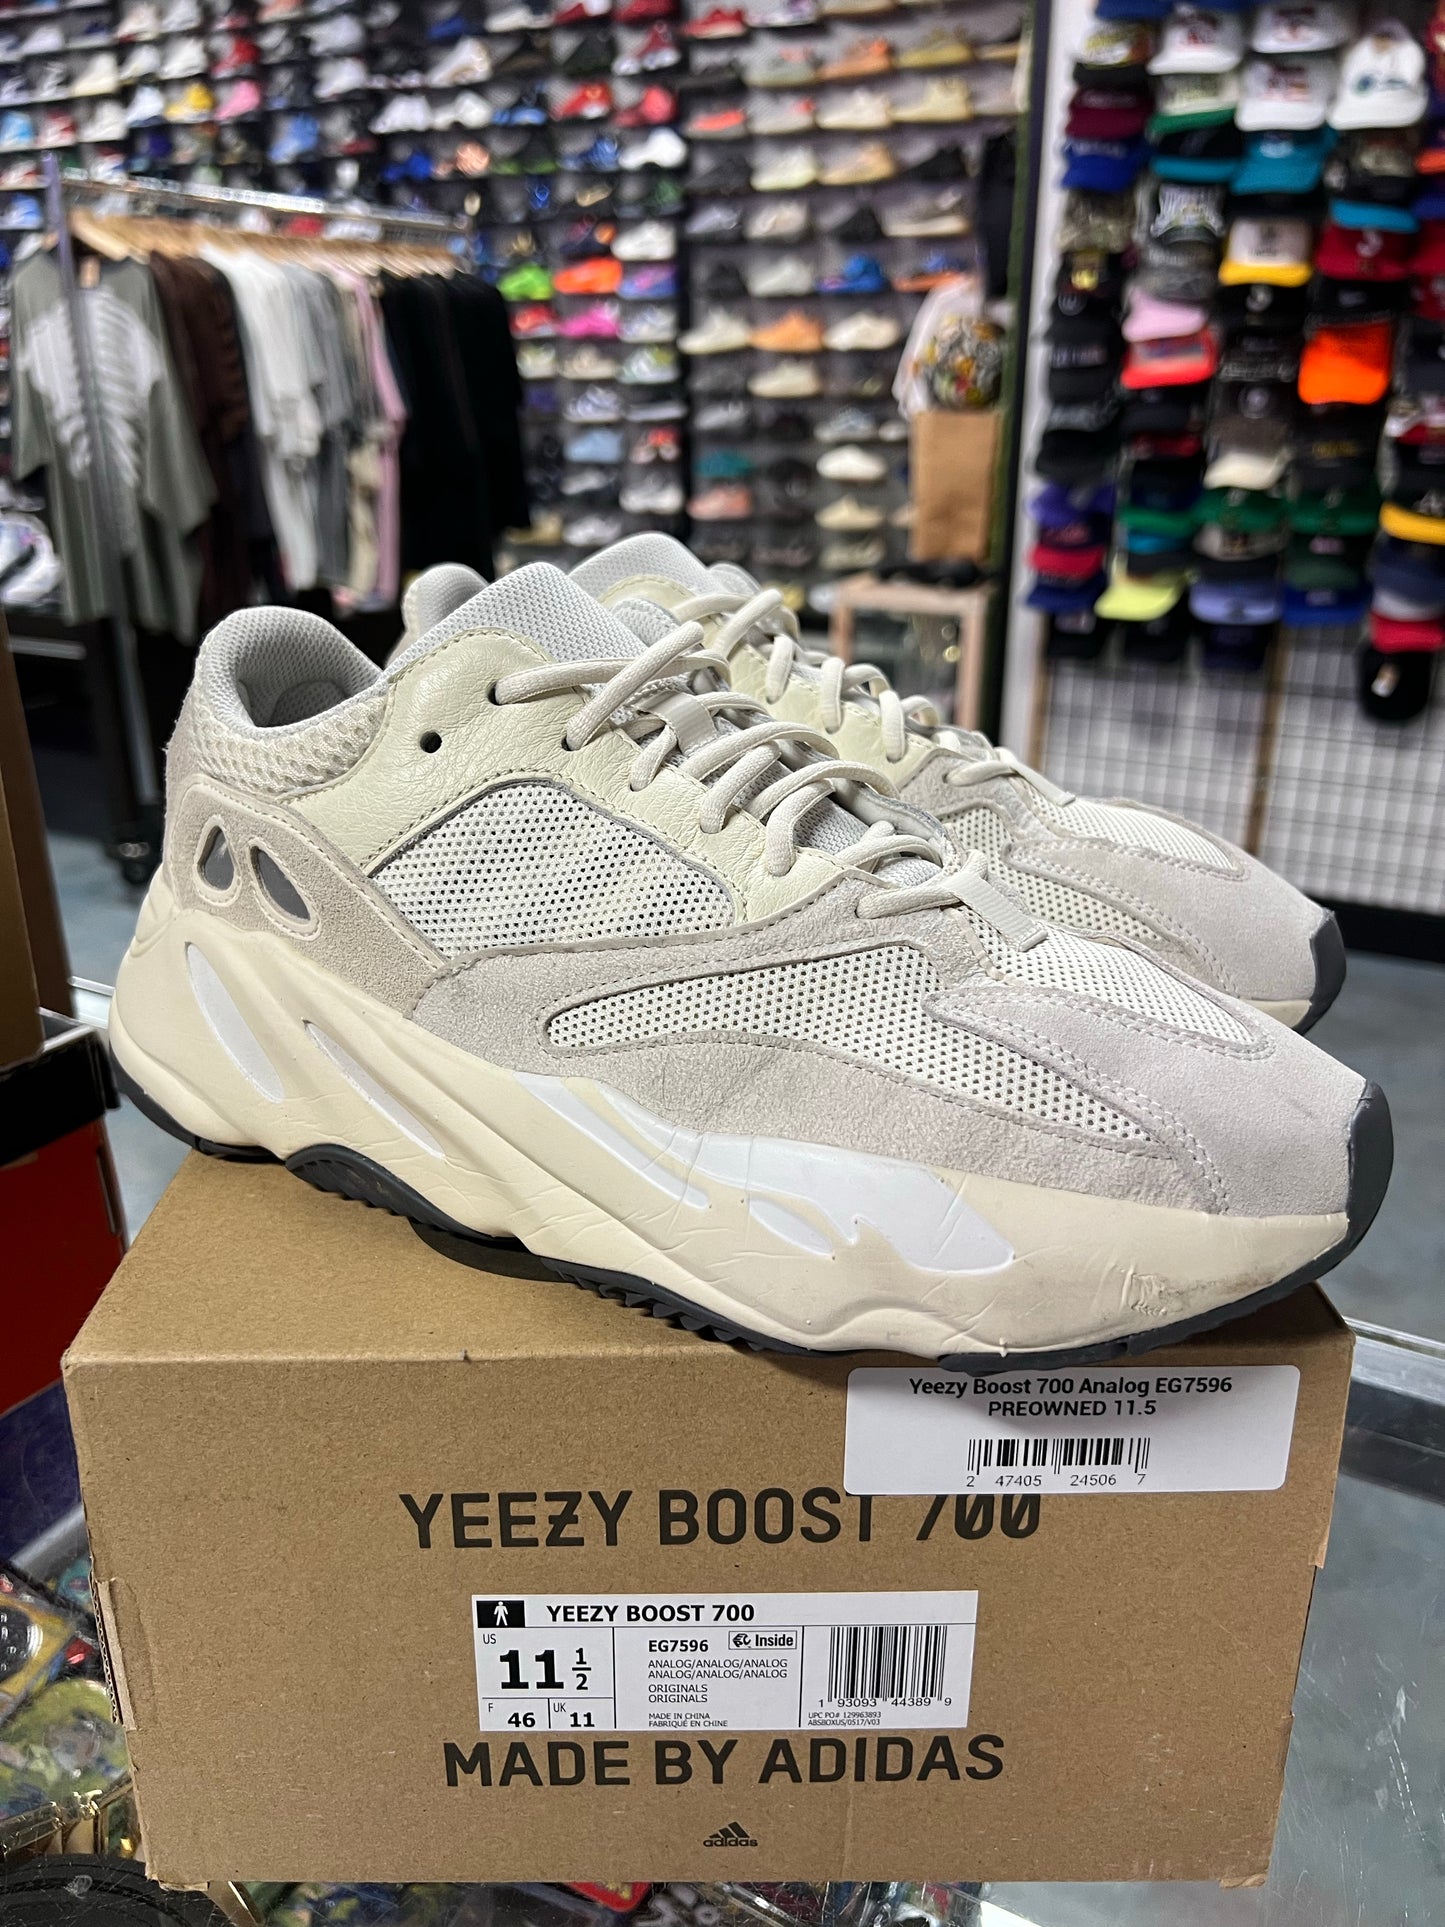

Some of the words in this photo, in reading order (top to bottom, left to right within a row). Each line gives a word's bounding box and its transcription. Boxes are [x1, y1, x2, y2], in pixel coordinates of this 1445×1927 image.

[909, 1378, 968, 1398] Yeezy
[973, 1378, 1032, 1394] Boost
[1037, 1378, 1074, 1394] 700
[1078, 1377, 1150, 1398] Analog
[1155, 1377, 1233, 1394] EG7596
[988, 1401, 1107, 1416] PREOWNED
[1114, 1400, 1157, 1416] 11.5
[965, 1475, 975, 1488] 2
[995, 1474, 1043, 1487] 47405
[1070, 1474, 1117, 1487] 24506
[1136, 1474, 1146, 1486] 7
[399, 1489, 633, 1549] YEEZY
[658, 1486, 887, 1546] BOOST
[546, 1604, 619, 1622] YEEZY
[626, 1604, 705, 1622] BOOST
[712, 1604, 755, 1622] 700
[482, 1633, 497, 1645] US
[648, 1639, 709, 1652] EG7596
[755, 1634, 794, 1647] Inside
[499, 1650, 565, 1690] 11
[648, 1658, 788, 1670] ANALOG/ANALOG/ANALOG
[648, 1669, 788, 1680] ANALOG/ANALOG/ANALOG
[648, 1684, 708, 1694] ORIGINALS
[648, 1694, 708, 1704] ORIGINALS
[837, 1698, 877, 1708] 93093
[891, 1698, 932, 1707] 44389
[944, 1698, 952, 1706] 9
[488, 1702, 494, 1712] F
[507, 1712, 536, 1728] 46
[553, 1702, 567, 1712] UK
[569, 1712, 595, 1728] 11
[648, 1718, 688, 1728] FABRIQUÉ
[690, 1720, 701, 1728] EN
[703, 1720, 728, 1728] CHINE
[443, 1741, 630, 1787] MADE
[654, 1740, 738, 1784] BY
[758, 1734, 1005, 1784] ADIDAS
[702, 1837, 758, 1847] adidas
